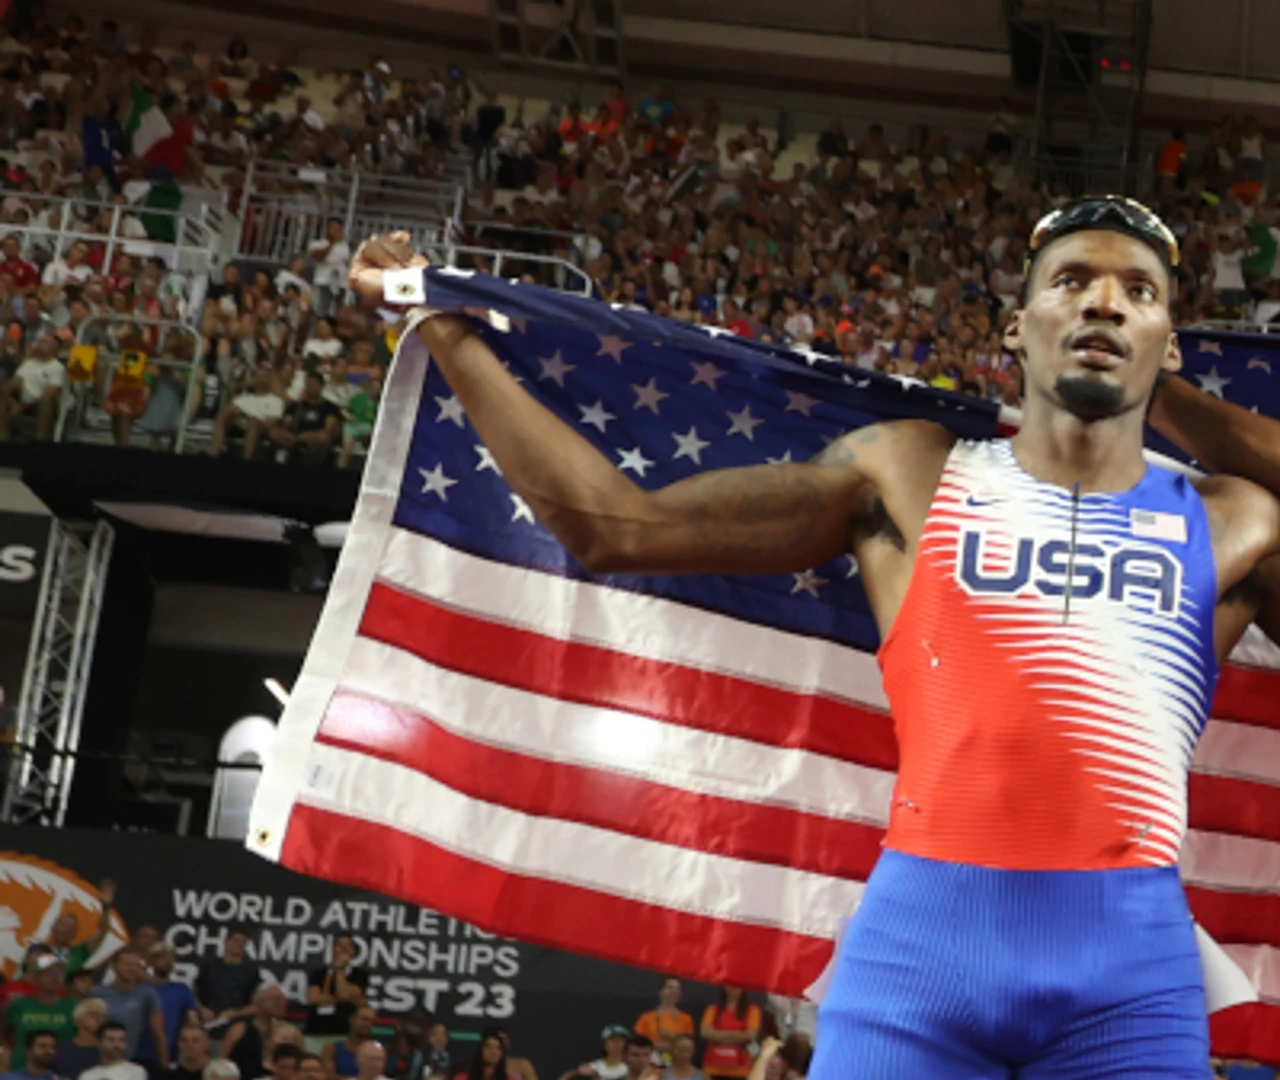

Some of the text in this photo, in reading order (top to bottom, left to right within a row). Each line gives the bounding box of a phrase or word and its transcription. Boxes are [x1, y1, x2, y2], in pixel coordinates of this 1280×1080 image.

[957, 529, 1180, 614] USA
[172, 888, 313, 926] WORLD
[453, 980, 518, 1019] 23
